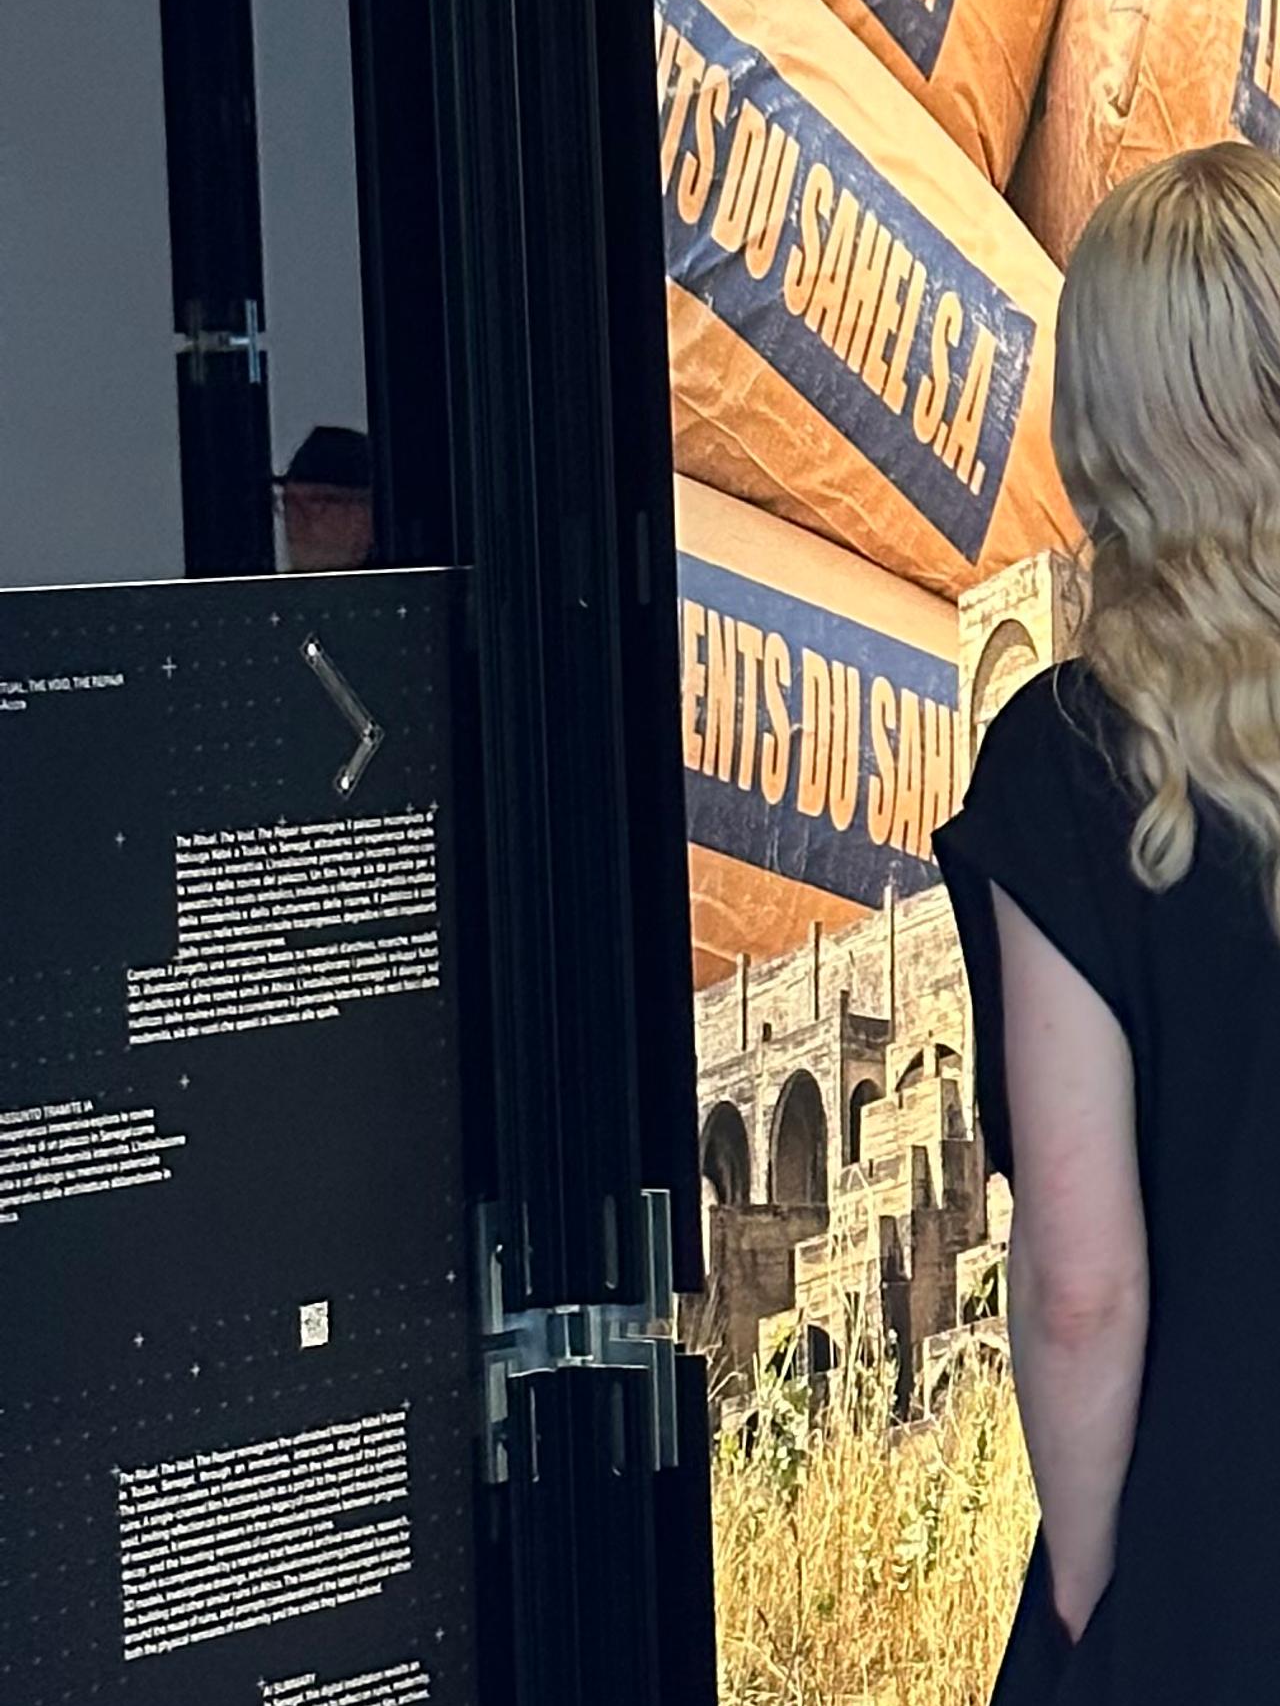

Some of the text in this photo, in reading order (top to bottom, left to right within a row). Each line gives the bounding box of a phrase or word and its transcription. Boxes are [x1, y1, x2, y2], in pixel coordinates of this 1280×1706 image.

[710, 97, 800, 280] DU
[783, 162, 927, 416] SAHEL
[912, 290, 999, 496] S.A.
[796, 647, 861, 832] DU
[867, 675, 960, 866] SAH
